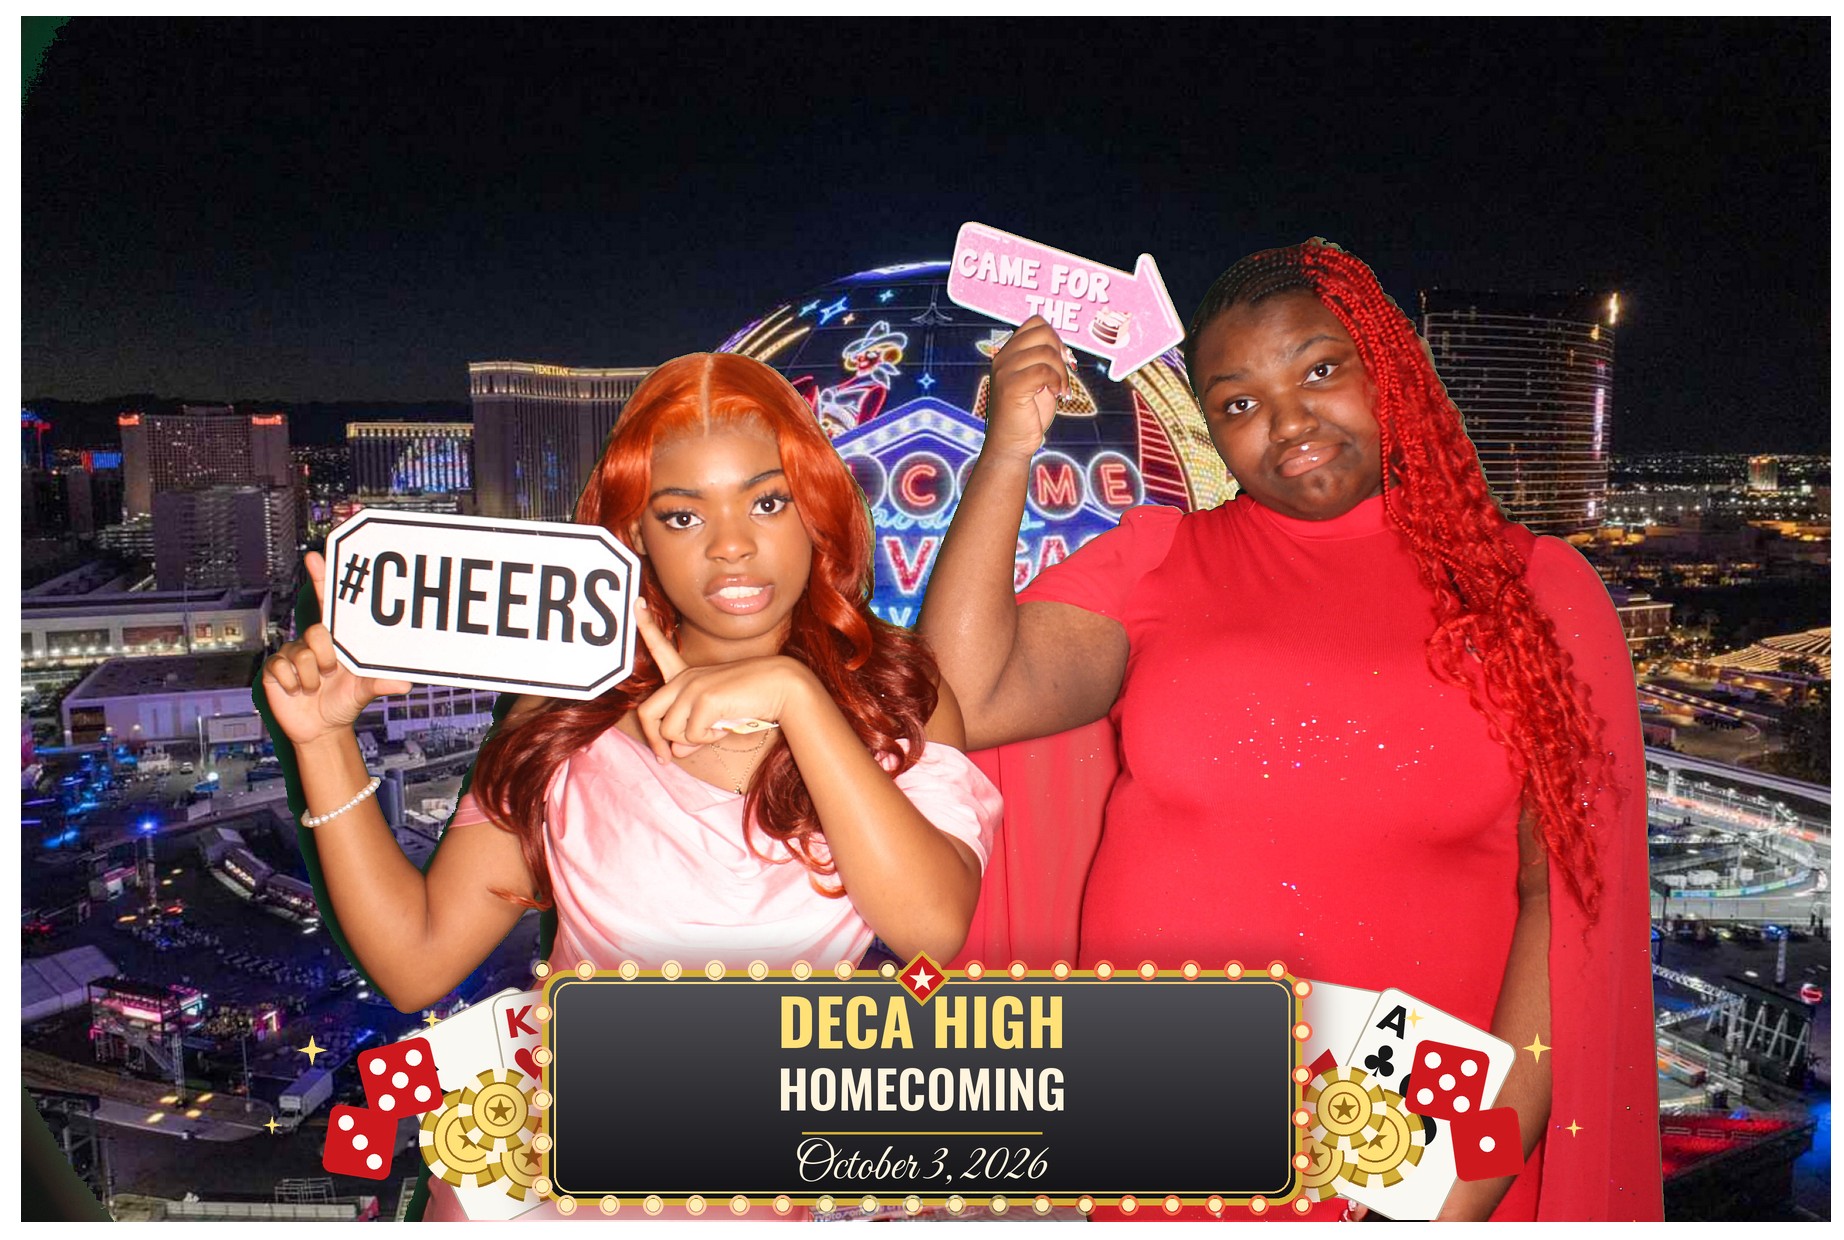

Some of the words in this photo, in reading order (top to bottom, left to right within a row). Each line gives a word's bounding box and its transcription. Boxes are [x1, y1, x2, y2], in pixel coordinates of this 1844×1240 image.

[957, 249, 1041, 290] CAME
[1051, 264, 1111, 304] FOR
[1025, 294, 1083, 333] THE
[337, 551, 621, 646] #CHEERS
